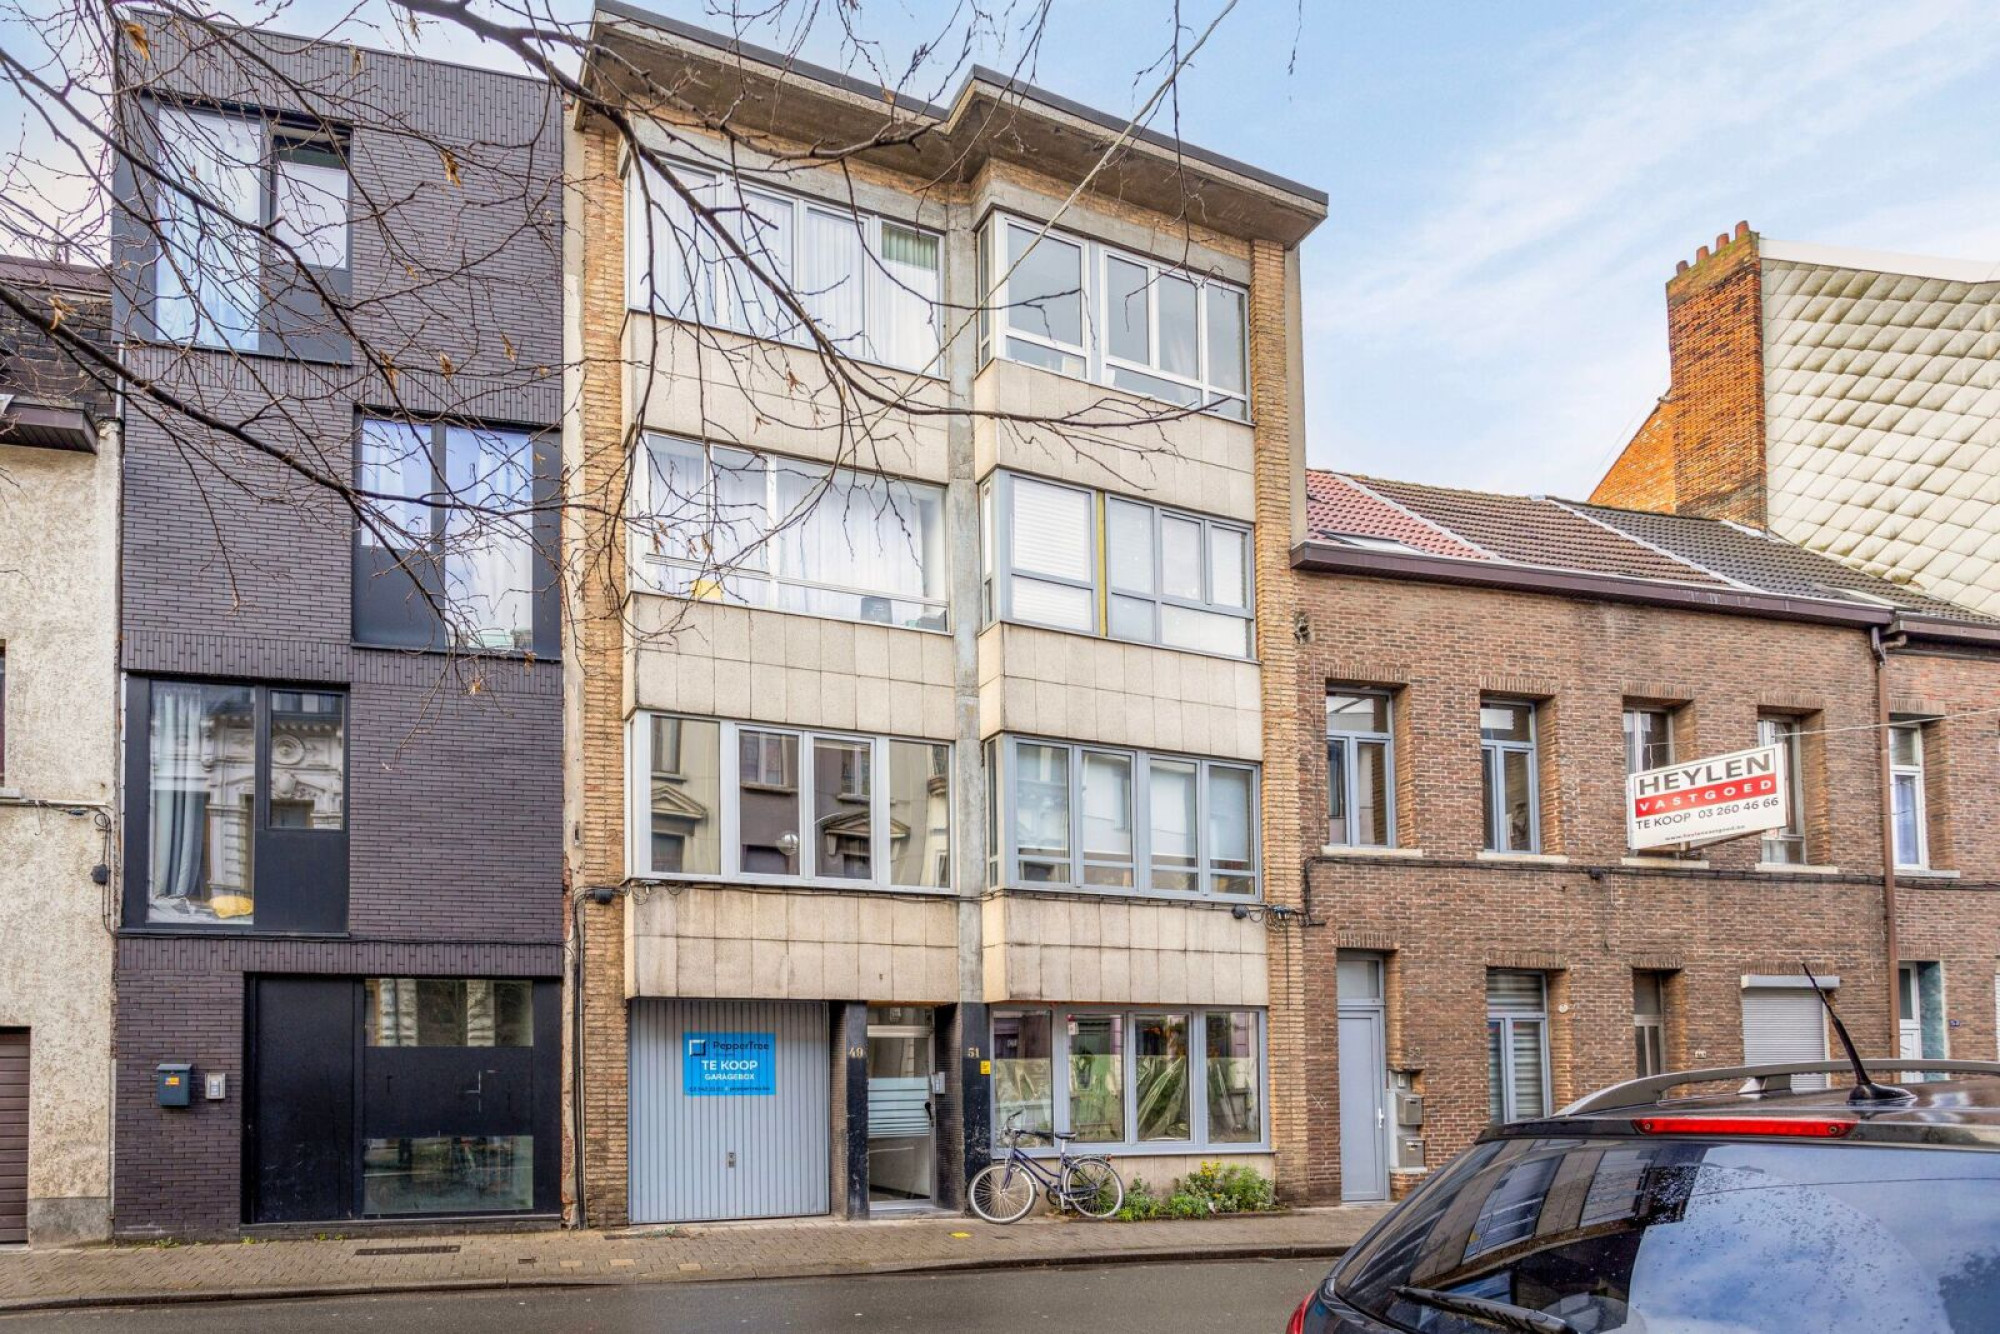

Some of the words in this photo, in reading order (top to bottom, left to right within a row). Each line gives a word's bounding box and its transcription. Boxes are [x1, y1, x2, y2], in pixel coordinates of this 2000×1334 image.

[1639, 753, 1770, 796] HEYLEN
[1639, 779, 1772, 811] VASTGOED
[1636, 820, 1651, 830] TE
[1654, 812, 1691, 826] KOOP
[1698, 808, 1714, 819] 03
[1717, 804, 1740, 815] 260
[1743, 800, 1760, 811] 46
[1763, 796, 1779, 808] 66
[713, 1040, 770, 1051] PepperTree
[849, 1046, 864, 1058] 49
[967, 1046, 980, 1058] 51
[701, 1060, 717, 1070] TE
[720, 1060, 758, 1070] KOOP
